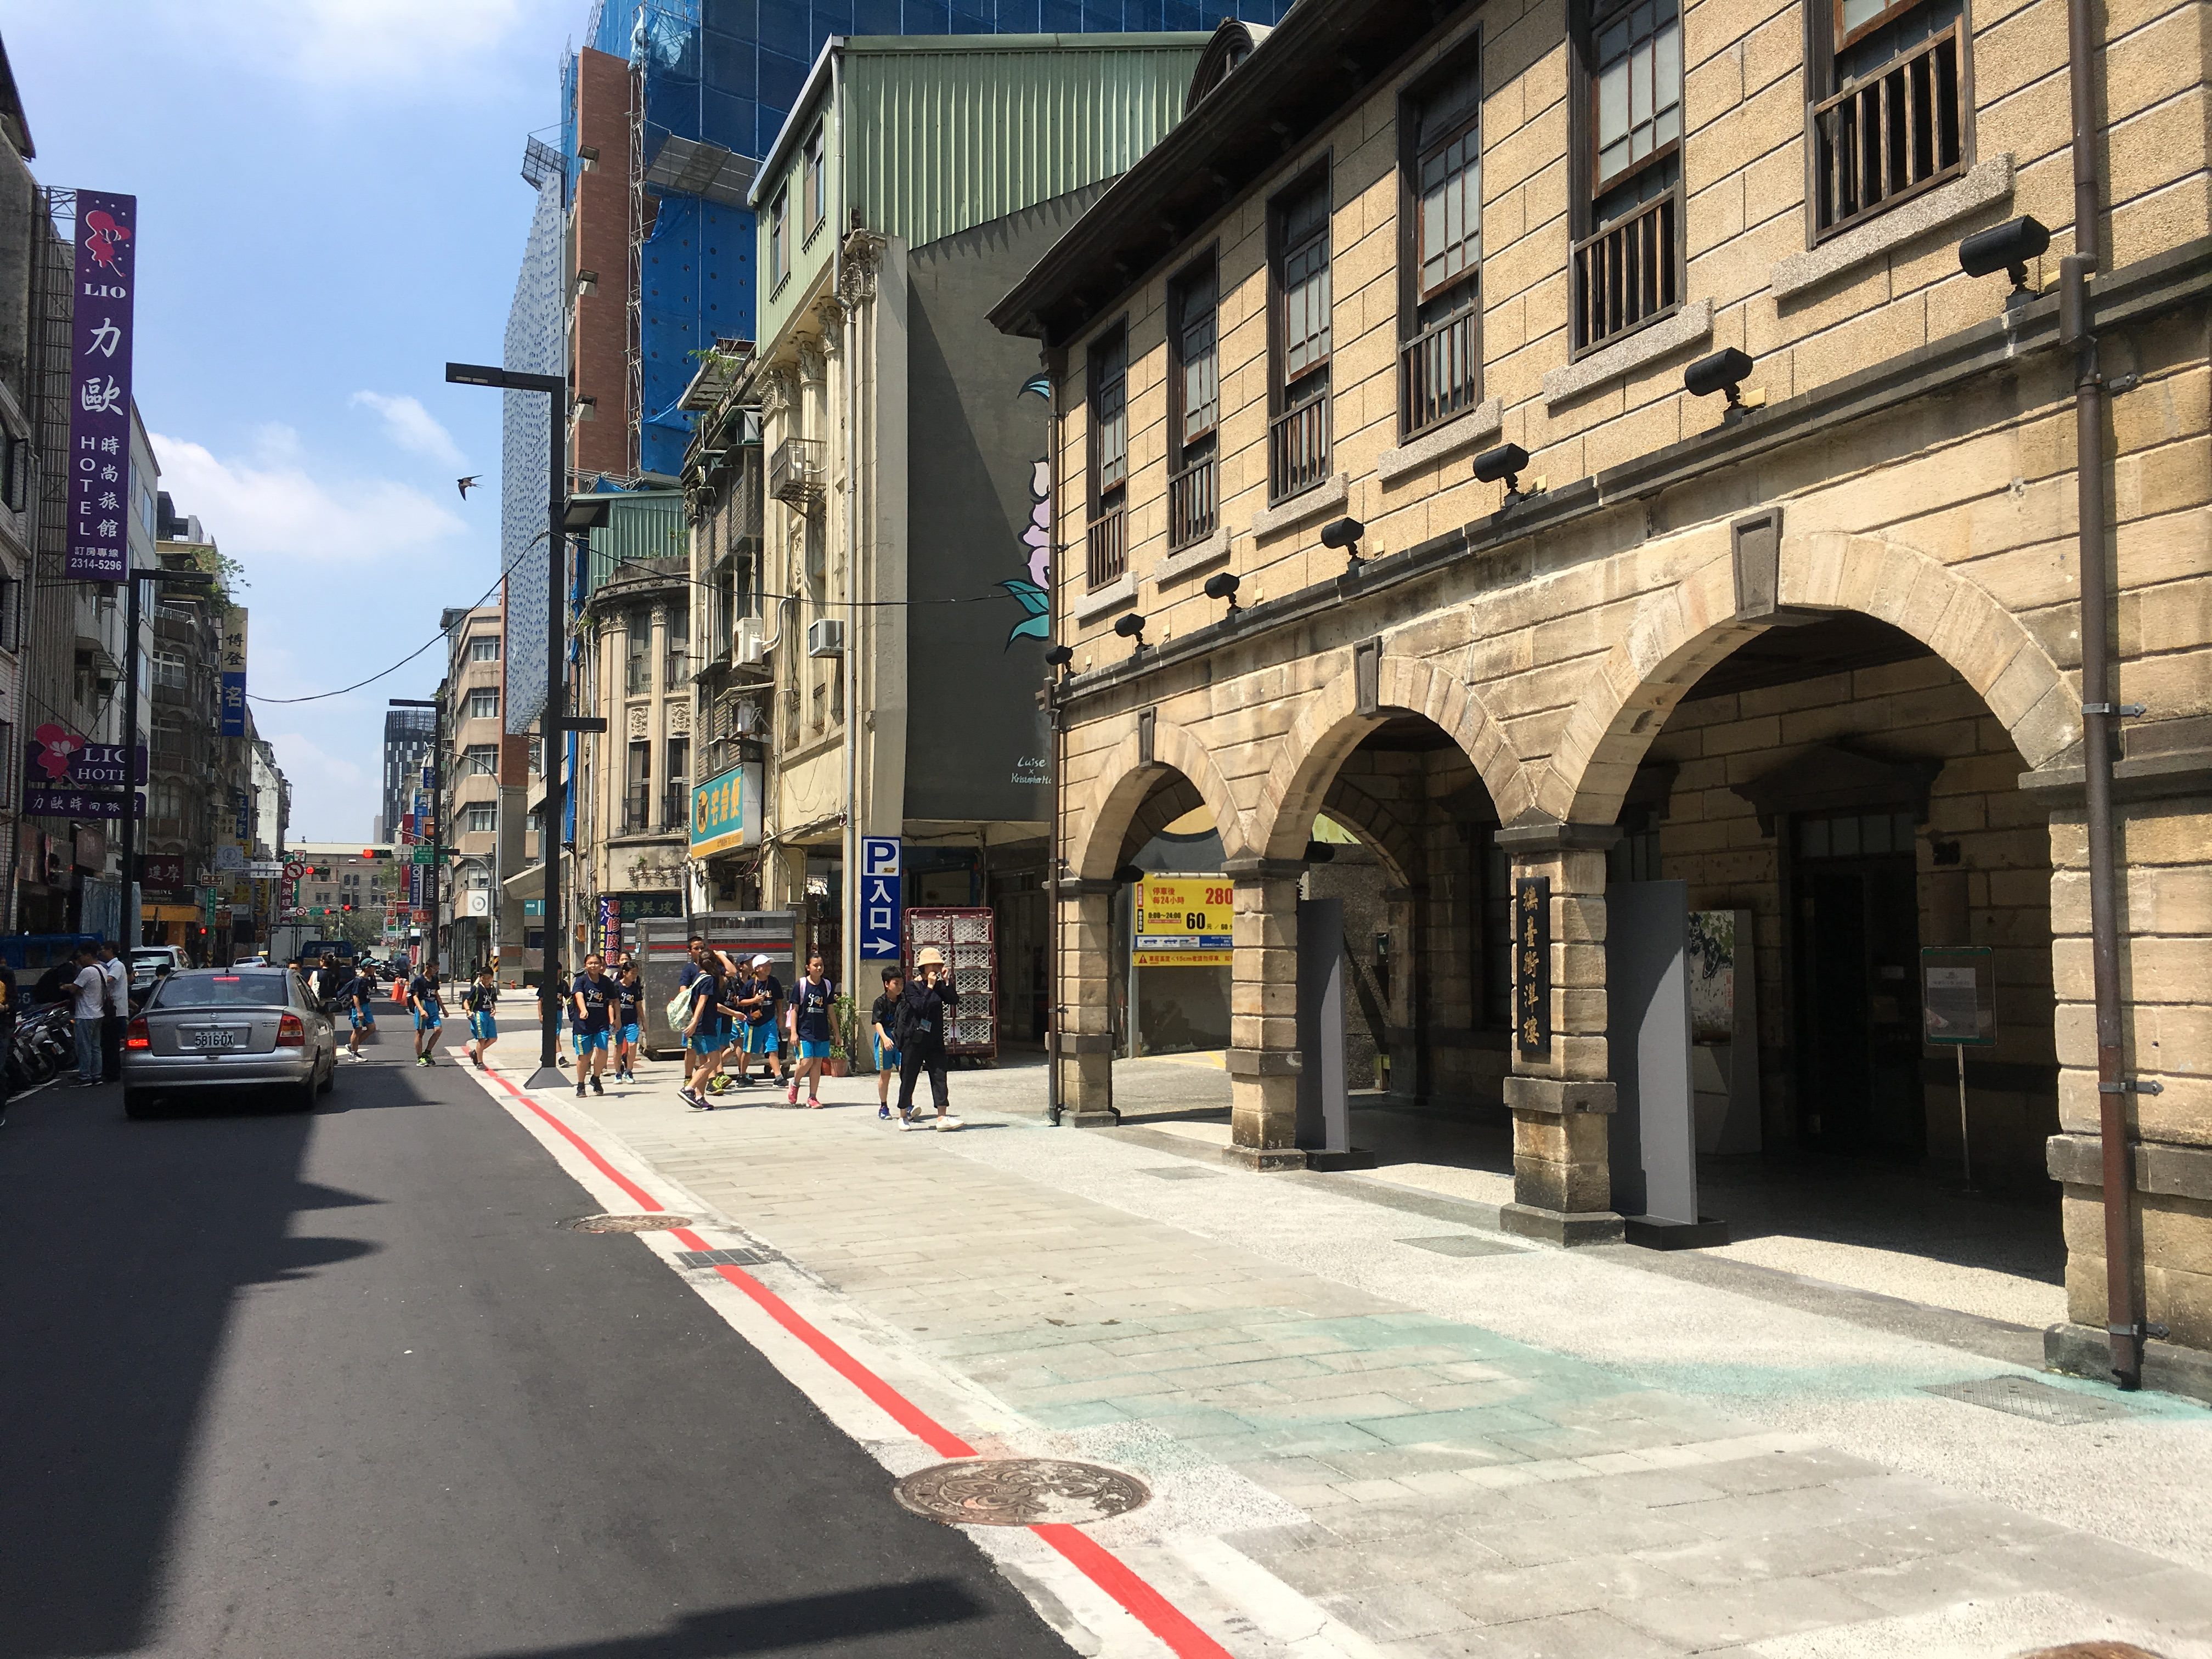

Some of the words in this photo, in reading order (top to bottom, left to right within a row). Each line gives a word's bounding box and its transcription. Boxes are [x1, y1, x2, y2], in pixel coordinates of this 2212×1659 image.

[83, 283, 126, 298] LIO
[82, 317, 123, 416] 力歐
[80, 436, 96, 535] HOTEL
[97, 436, 120, 538] 時尚旅館
[75, 546, 119, 558] 訂房專線
[71, 557, 122, 571] 2314-5296
[1017, 755, 1047, 768] Luise
[710, 776, 741, 826] 宅急便
[867, 842, 896, 874] P
[1153, 887, 1175, 895] 停車後
[1205, 888, 1233, 905] 280
[622, 900, 683, 915] 發美皮
[869, 879, 893, 930] 入口
[1186, 912, 1205, 930] 60
[605, 900, 620, 966] 專修皮鞋
